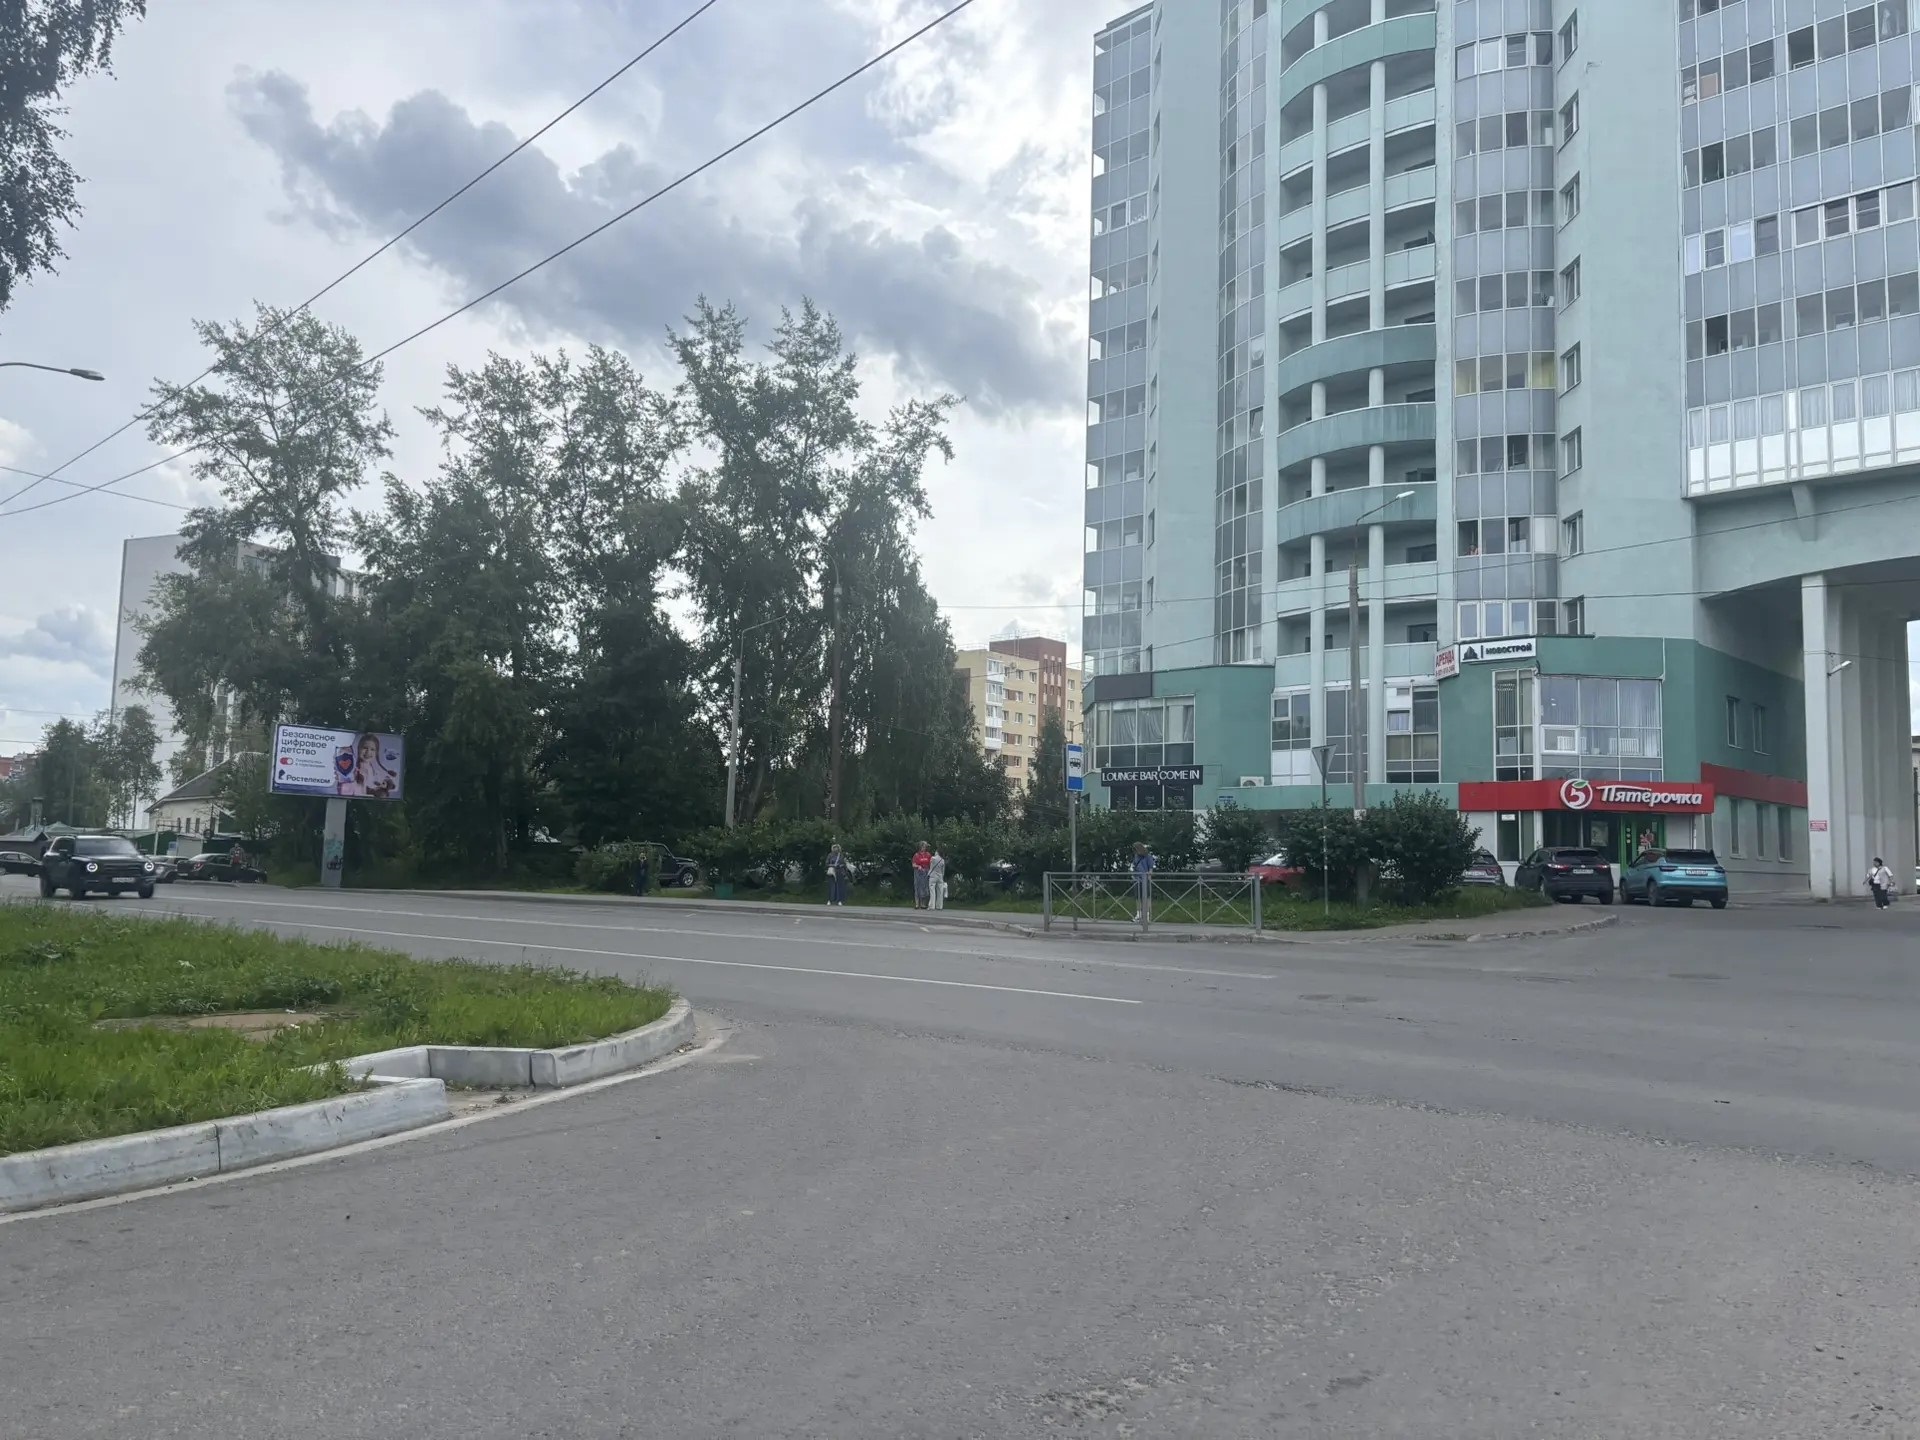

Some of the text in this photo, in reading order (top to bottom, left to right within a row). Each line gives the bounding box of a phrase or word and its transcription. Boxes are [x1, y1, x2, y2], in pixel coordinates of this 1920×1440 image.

[1486, 643, 1532, 655] НОВОСТРОЙ
[1436, 649, 1455, 667] АРЕНДА
[282, 729, 336, 742] Безопасное
[281, 739, 328, 749] цифровое
[280, 746, 317, 756] детство
[286, 774, 331, 784] Ростелеком
[1102, 769, 1200, 782] LOUNGE BAR COME IN
